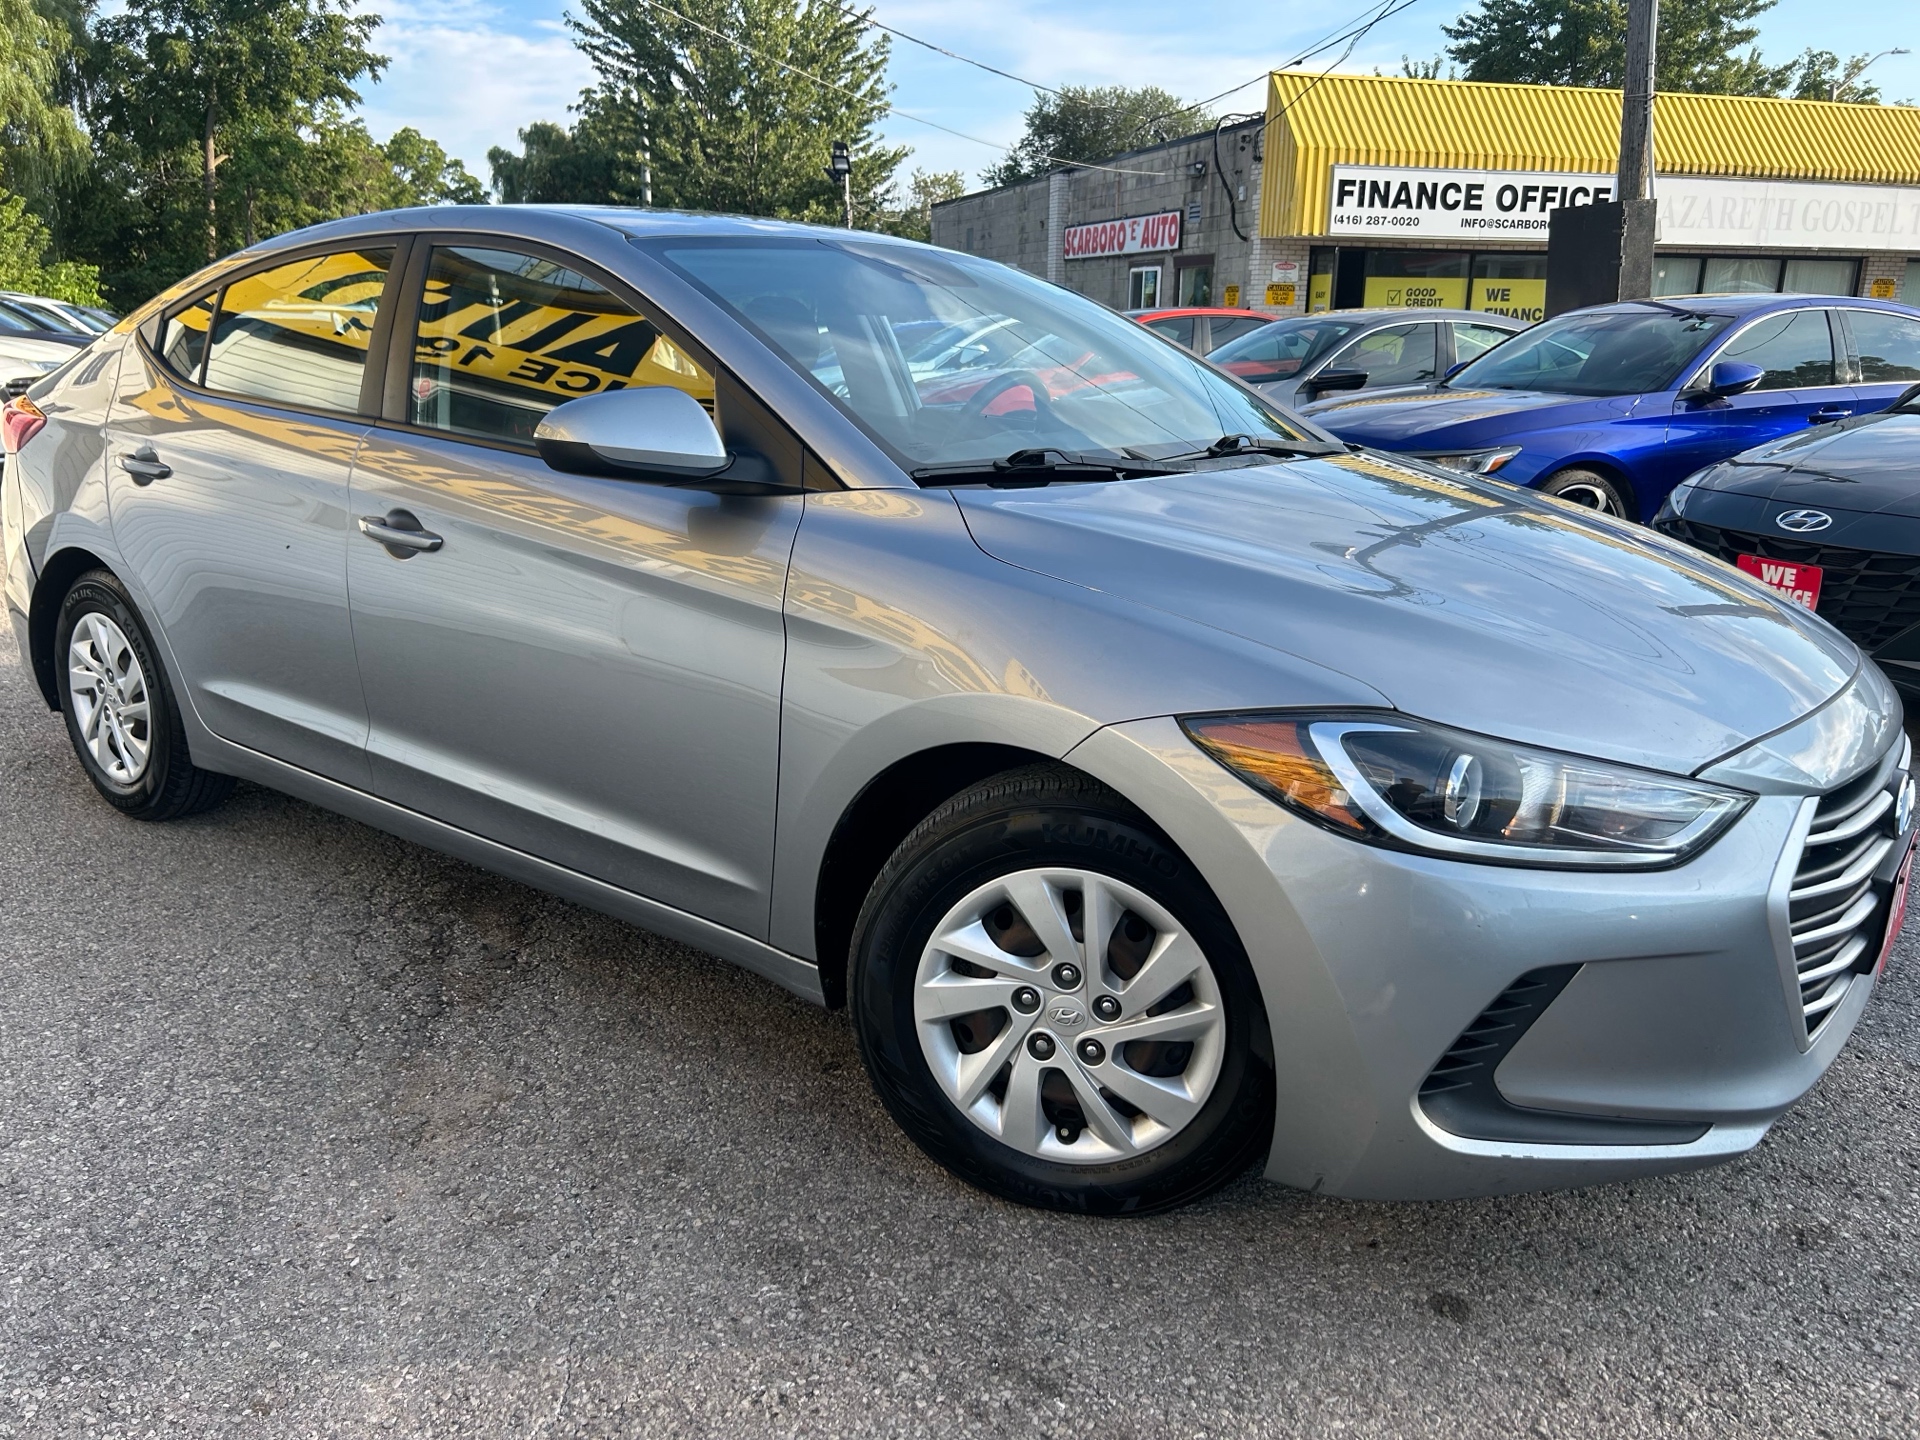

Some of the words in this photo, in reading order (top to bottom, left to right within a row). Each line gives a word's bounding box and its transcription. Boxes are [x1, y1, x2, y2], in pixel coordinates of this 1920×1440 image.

[1336, 179, 1485, 211] FINANCE
[1334, 214, 1362, 225] (416)
[1366, 216, 1420, 227] 287-0020
[1460, 218, 1550, 230] INFO@SCARBOR
[1659, 195, 1798, 232] AZARETH
[1802, 198, 1904, 236] GOSPEL
[1065, 222, 1127, 257] SCARBORO
[1141, 213, 1179, 248] AUTO
[1268, 284, 1294, 292] CAUTION
[1406, 288, 1437, 298] GOOD
[1486, 288, 1511, 302] WE
[1405, 298, 1444, 308] CREDIT
[1761, 563, 1797, 588] WE
[122, 617, 155, 690] KUMHO
[1041, 822, 1181, 880] KUMHO
